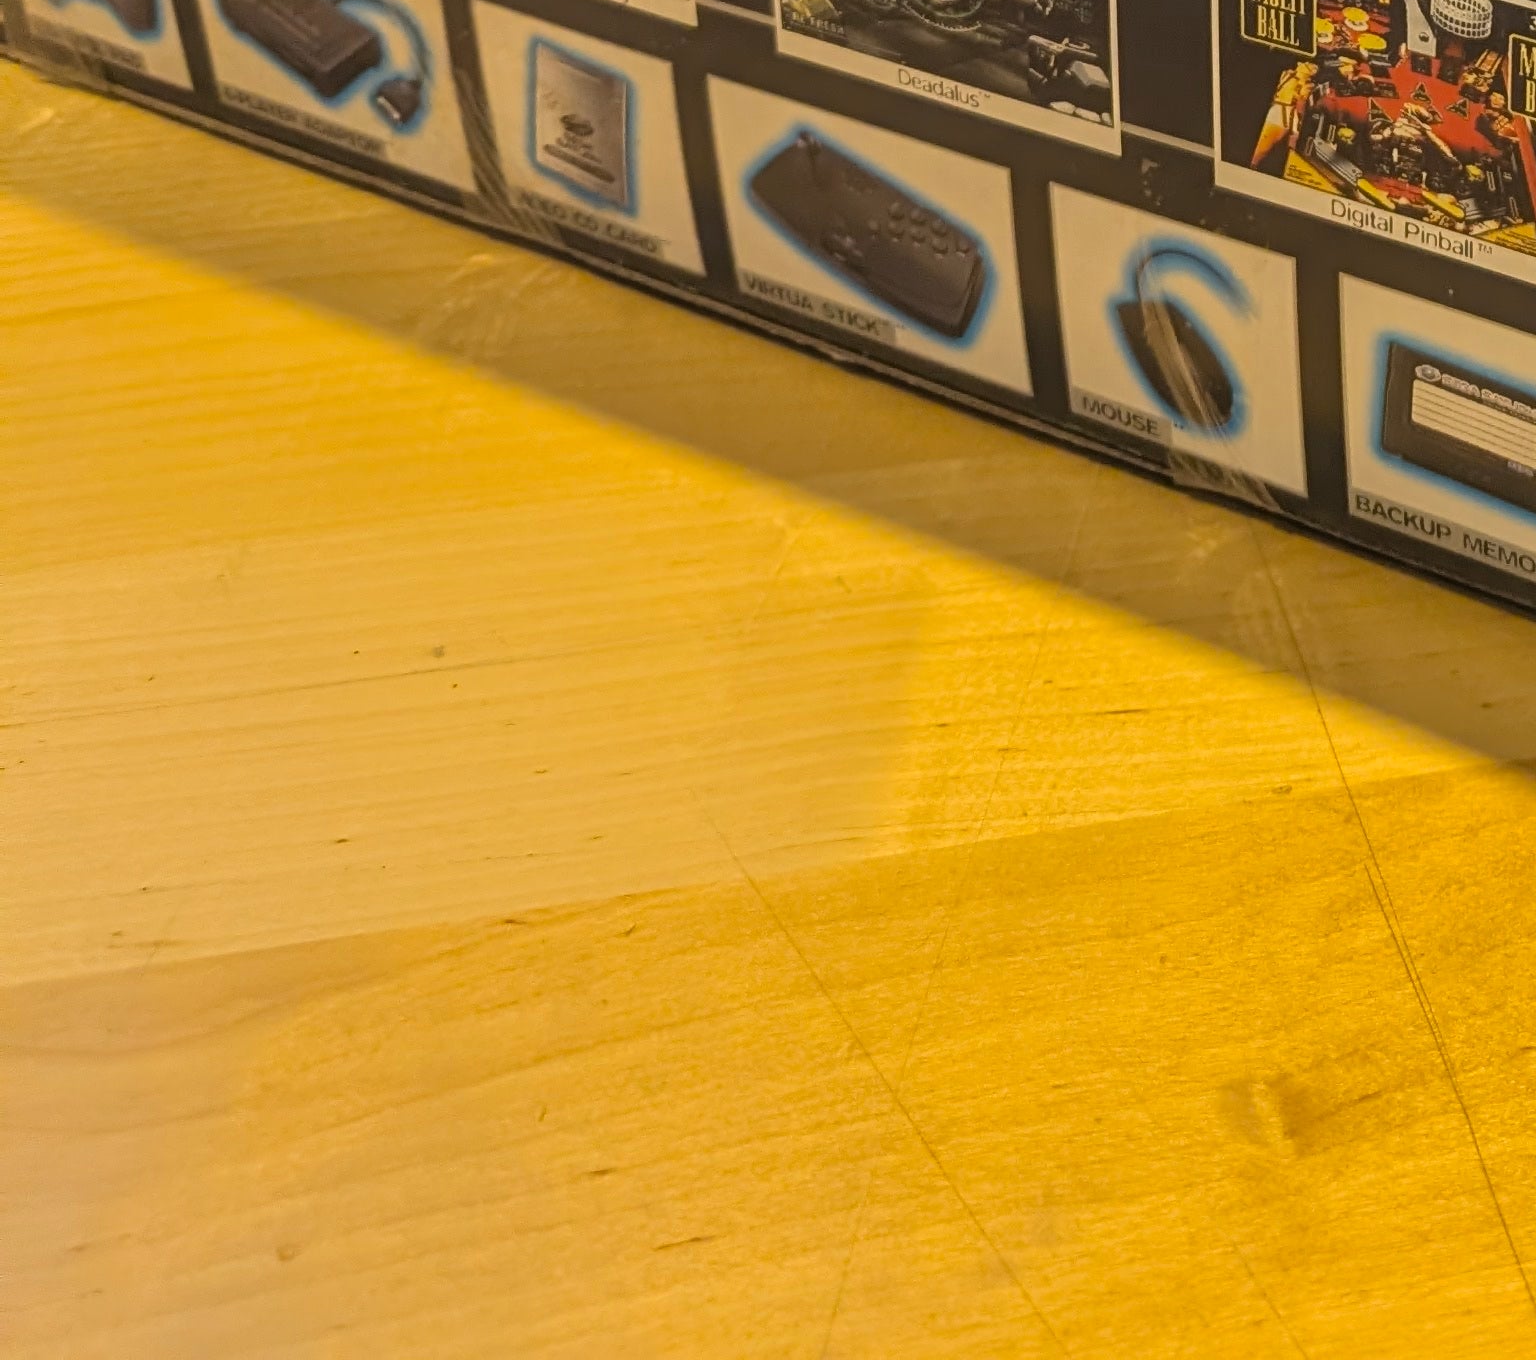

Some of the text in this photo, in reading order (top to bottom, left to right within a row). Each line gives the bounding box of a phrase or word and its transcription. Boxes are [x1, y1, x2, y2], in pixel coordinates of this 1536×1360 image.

[1256, 5, 1301, 47] BALL
[1330, 198, 1394, 235] Digital
[1080, 394, 1160, 439] MOUSE
[1355, 492, 1452, 541] BACKUP
